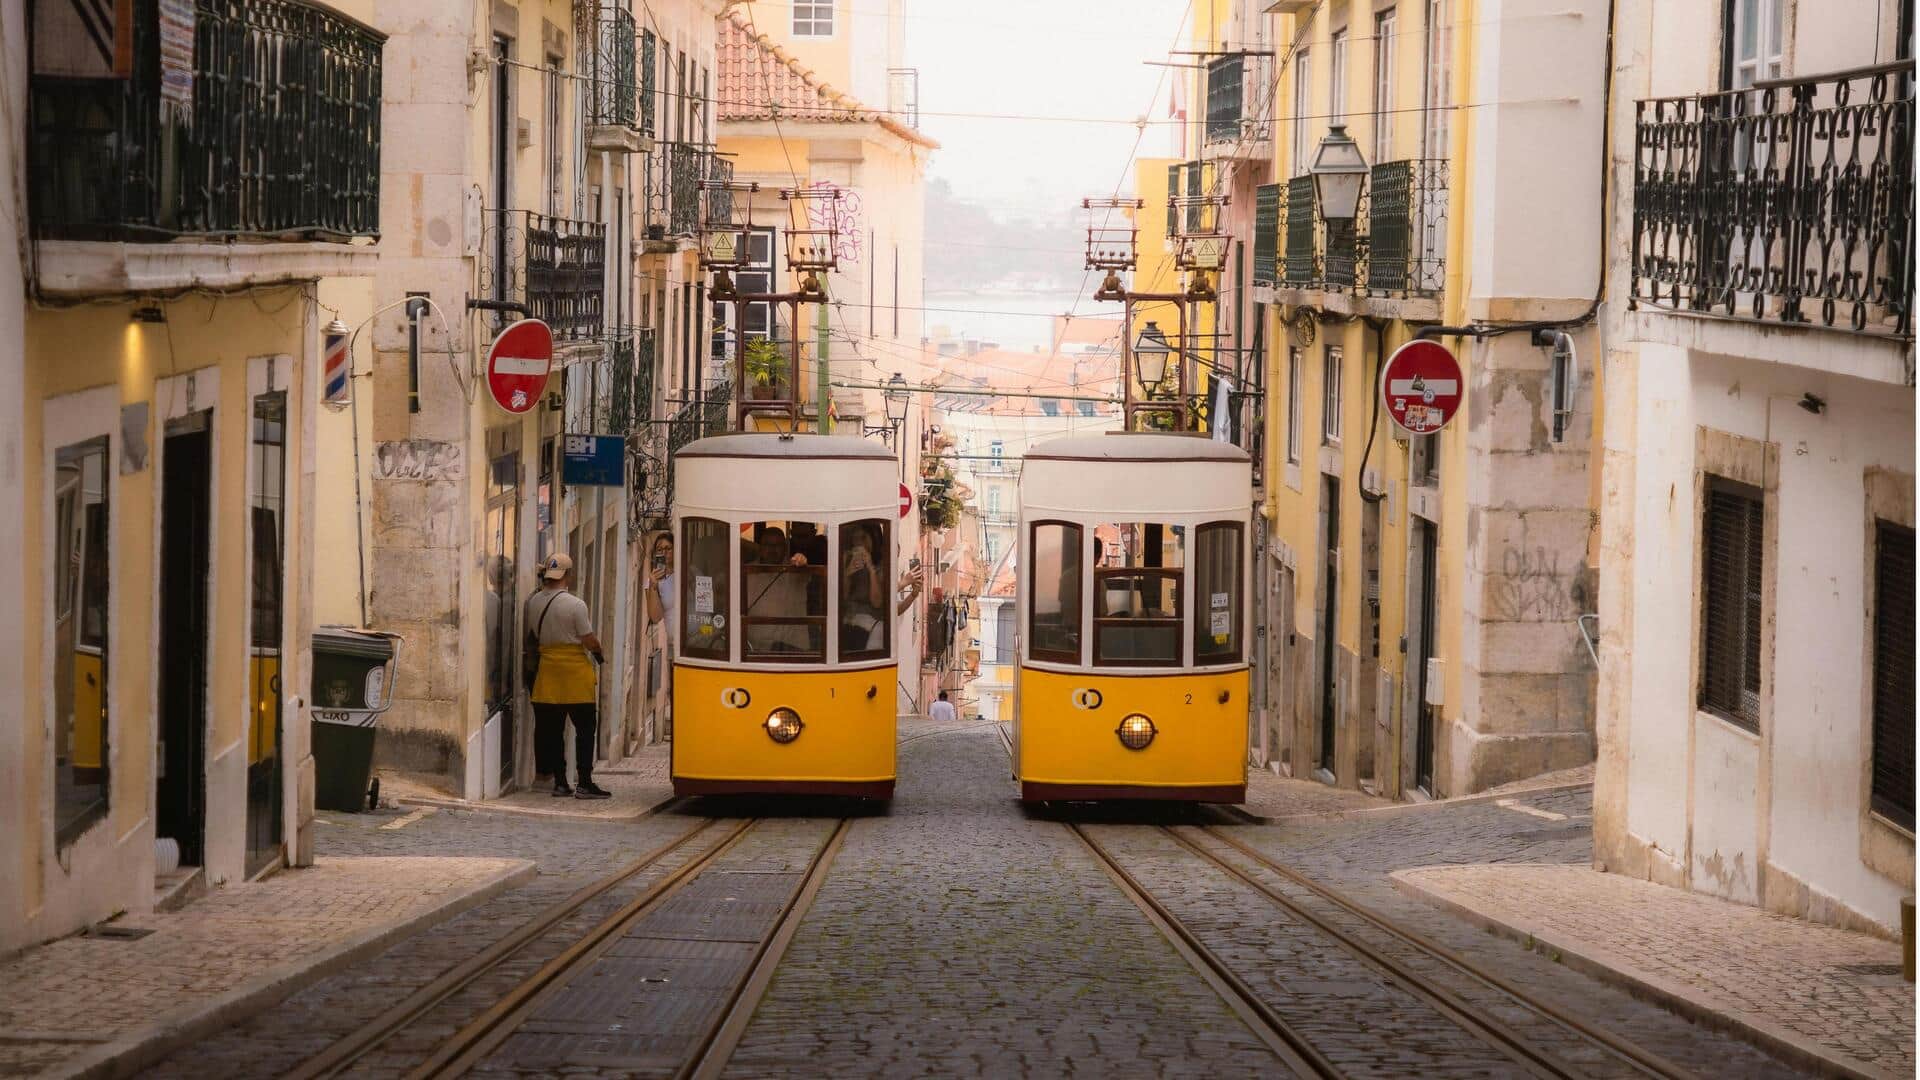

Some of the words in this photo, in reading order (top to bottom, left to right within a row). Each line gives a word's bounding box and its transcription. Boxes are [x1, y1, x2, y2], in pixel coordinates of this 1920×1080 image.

[829, 687, 835, 699] 1
[1184, 693, 1192, 705] 2
[322, 712, 350, 721] LIXO
